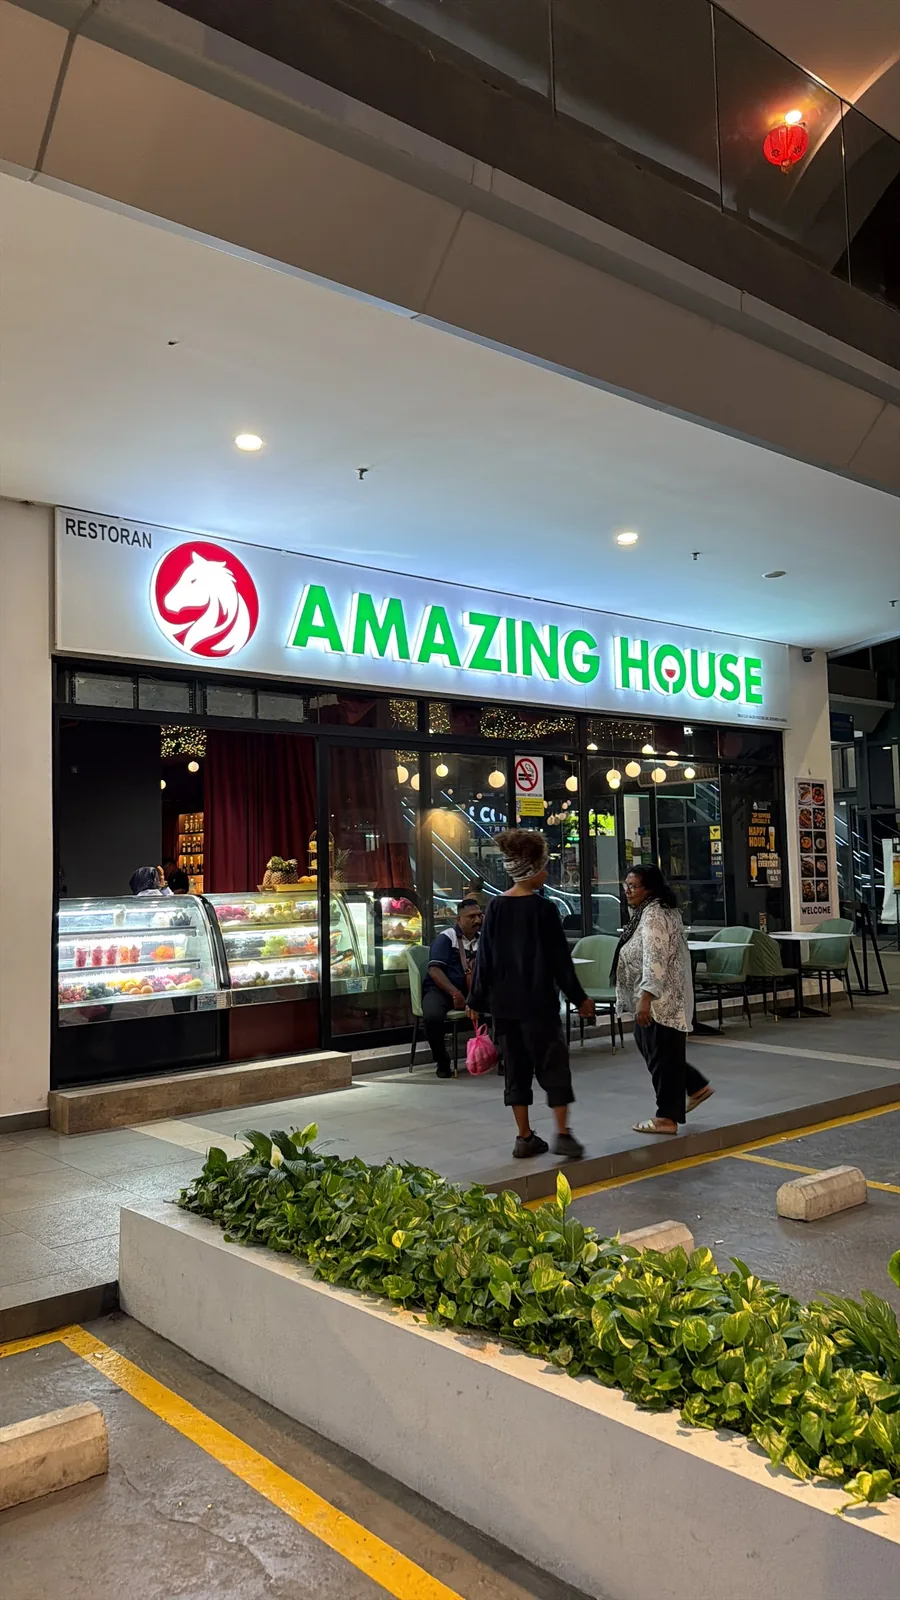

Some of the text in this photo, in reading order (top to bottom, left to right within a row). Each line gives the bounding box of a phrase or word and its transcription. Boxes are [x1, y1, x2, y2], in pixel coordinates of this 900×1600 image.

[65, 517, 152, 549] RESTORAN
[288, 584, 763, 705] AMAZING HOUSE
[748, 826, 766, 836] HAPPY
[749, 837, 766, 847] HOUR
[801, 906, 831, 915] WELCOME
